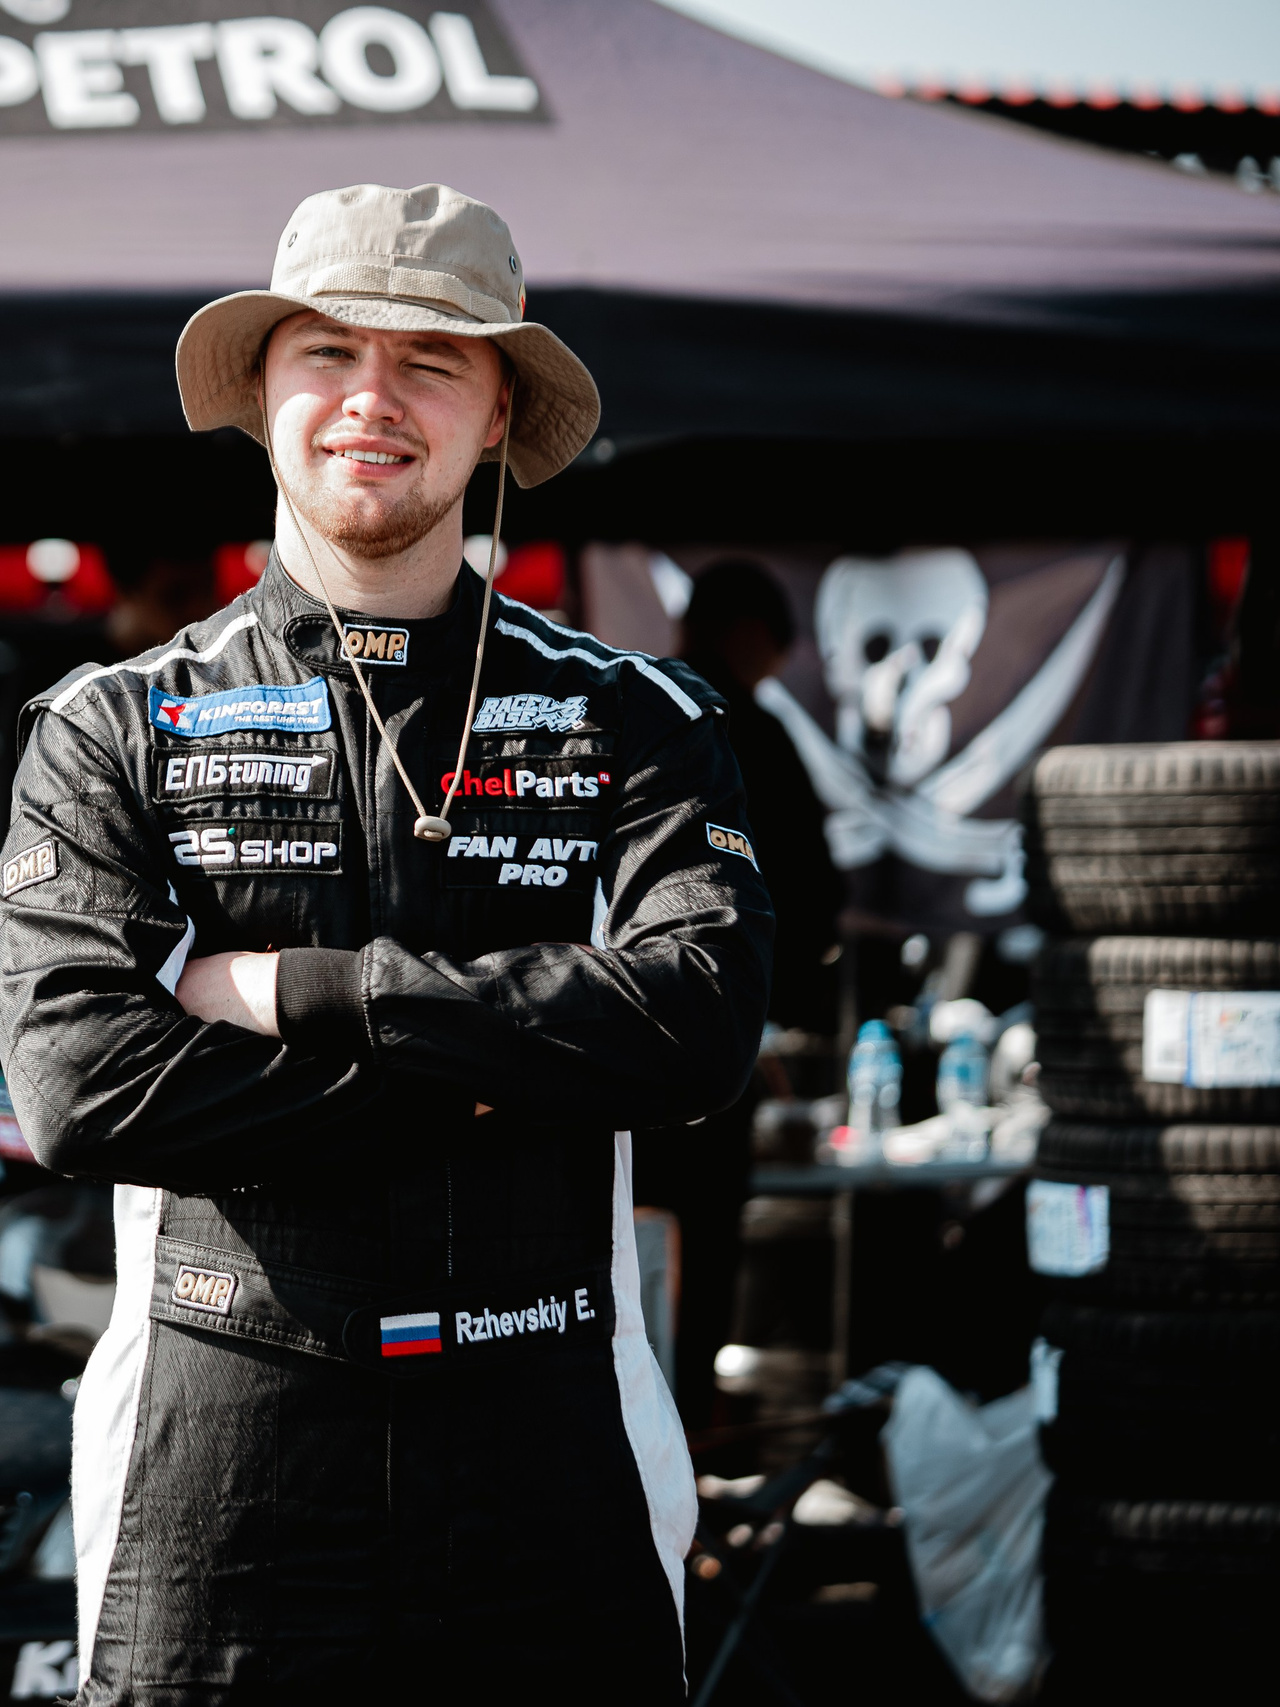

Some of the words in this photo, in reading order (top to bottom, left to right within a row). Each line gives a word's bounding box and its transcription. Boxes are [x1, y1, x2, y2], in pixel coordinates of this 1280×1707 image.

[346, 630, 406, 660] OMP
[197, 698, 323, 723] KINFOREST
[482, 695, 545, 713] RACE
[234, 716, 252, 724] THE
[297, 716, 320, 725] TYRE
[474, 711, 538, 730] BASE
[440, 769, 600, 798] ChelParts
[240, 840, 337, 865] SHOP
[447, 836, 517, 858] FAN
[527, 838, 600, 862] AVT
[6, 846, 52, 889] OMP
[498, 863, 568, 887] PRO
[177, 1272, 230, 1306] OMP
[455, 1295, 567, 1344] Rzhevskiy
[574, 1288, 596, 1321] E.
